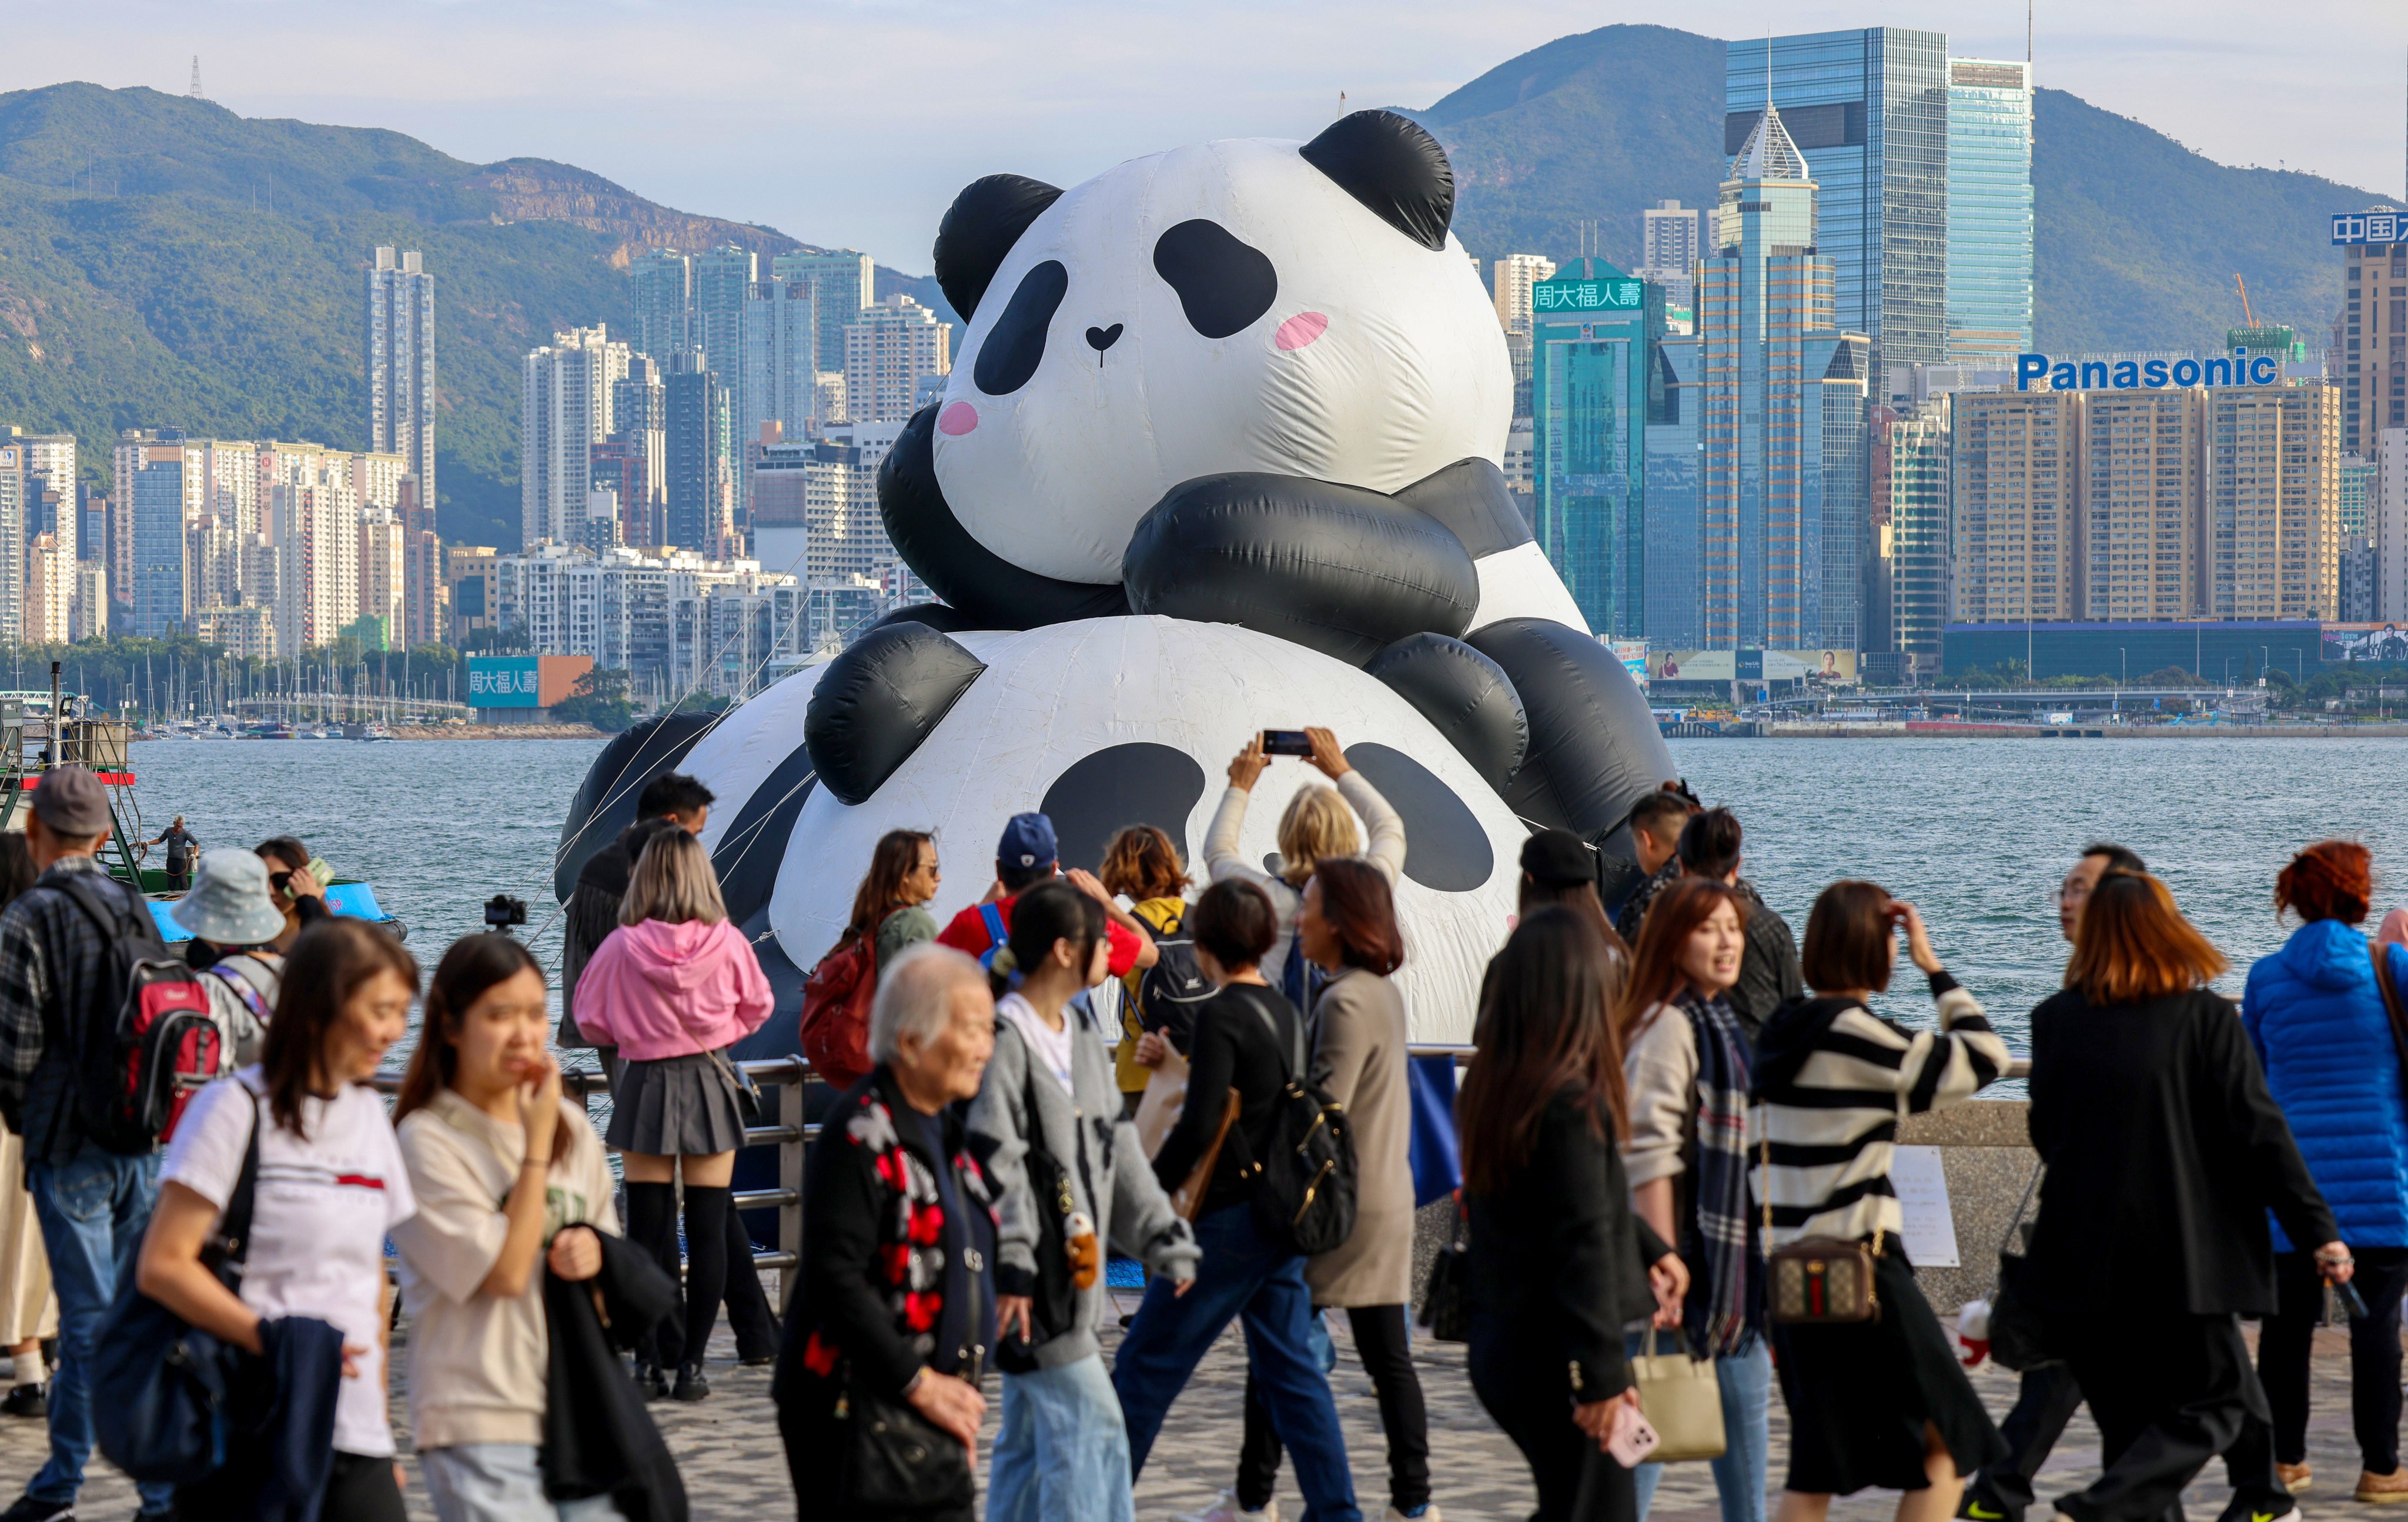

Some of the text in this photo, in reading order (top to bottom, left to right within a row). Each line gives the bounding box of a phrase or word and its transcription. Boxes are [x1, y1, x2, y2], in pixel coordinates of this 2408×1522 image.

[1534, 283, 1640, 308] 周大福人壽
[2018, 346, 2277, 391] Panasonic
[469, 671, 537, 694] 周大福人壽
